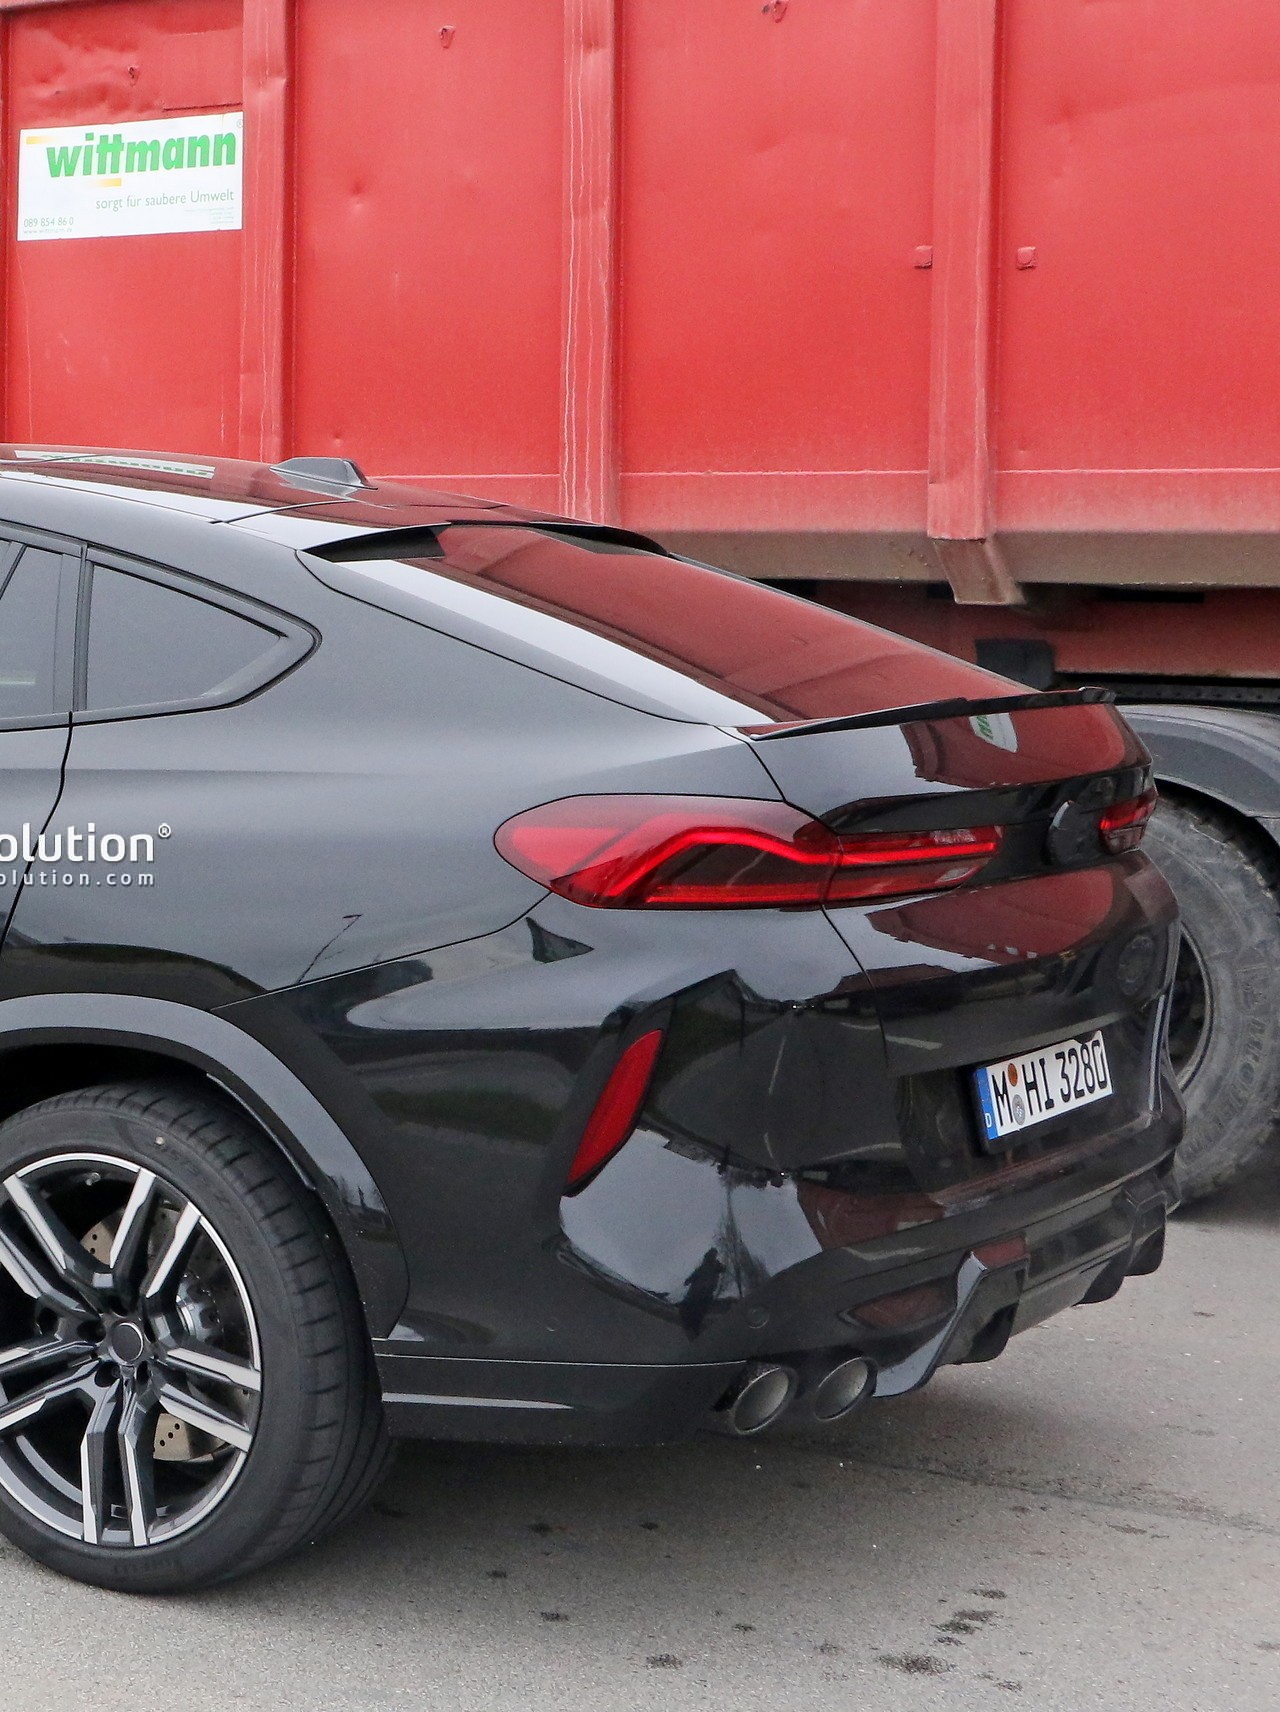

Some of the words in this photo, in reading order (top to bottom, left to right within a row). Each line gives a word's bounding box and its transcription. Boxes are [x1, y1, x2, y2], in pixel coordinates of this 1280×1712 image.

[46, 132, 237, 178] wittmann
[95, 198, 123, 212] sorgt
[126, 195, 142, 207] für
[145, 193, 187, 206] saubere
[190, 188, 234, 203] Umwelt
[23, 218, 38, 228] 089
[40, 217, 55, 227] 854
[57, 216, 68, 226] 86
[992, 1070, 1014, 1127] M
[1022, 1057, 1055, 1116] HI
[1055, 1039, 1108, 1103] 3280
[984, 1112, 992, 1128] D
